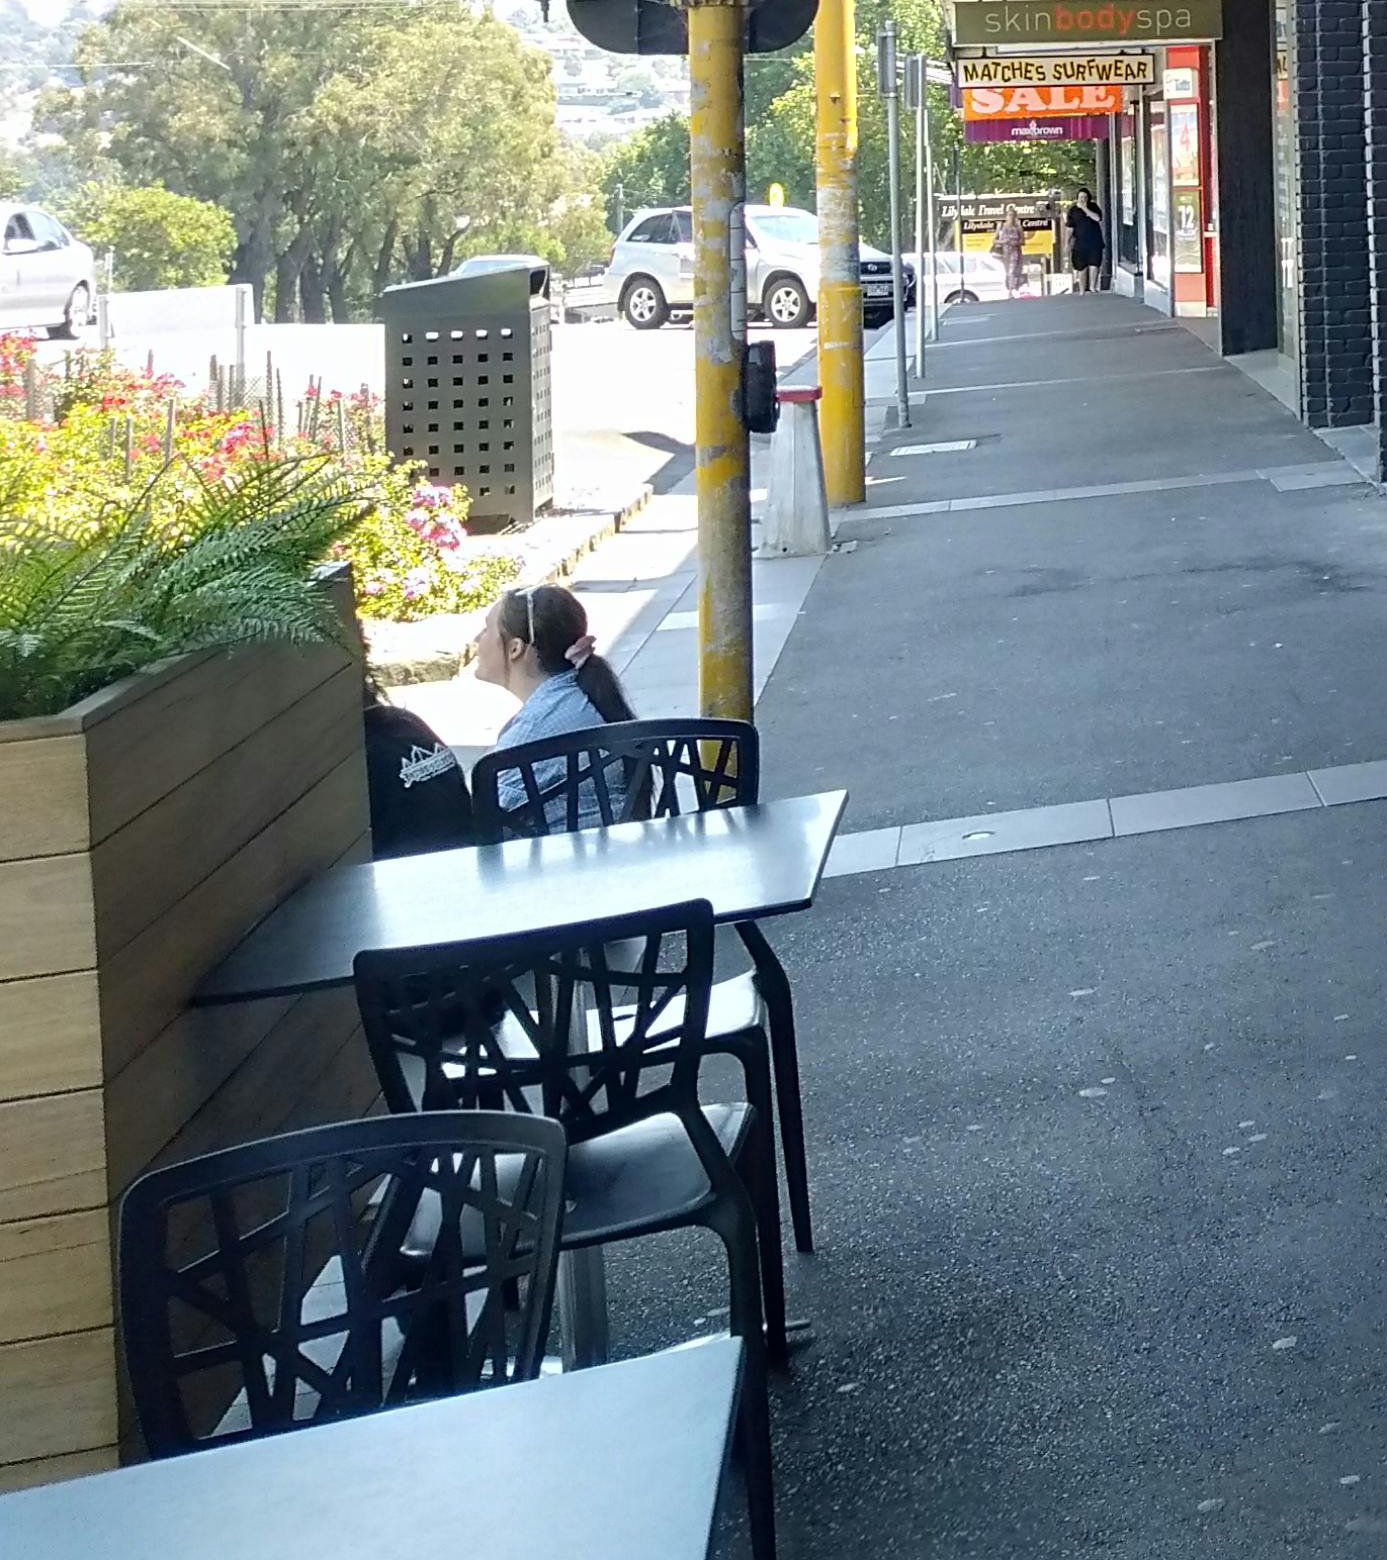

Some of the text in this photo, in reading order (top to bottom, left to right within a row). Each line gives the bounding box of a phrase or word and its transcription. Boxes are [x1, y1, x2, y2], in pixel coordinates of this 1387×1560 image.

[984, 3, 1192, 35] skinbodyspa
[963, 58, 1148, 83] MATCHES SURFWEAR
[970, 85, 1117, 114] SALE
